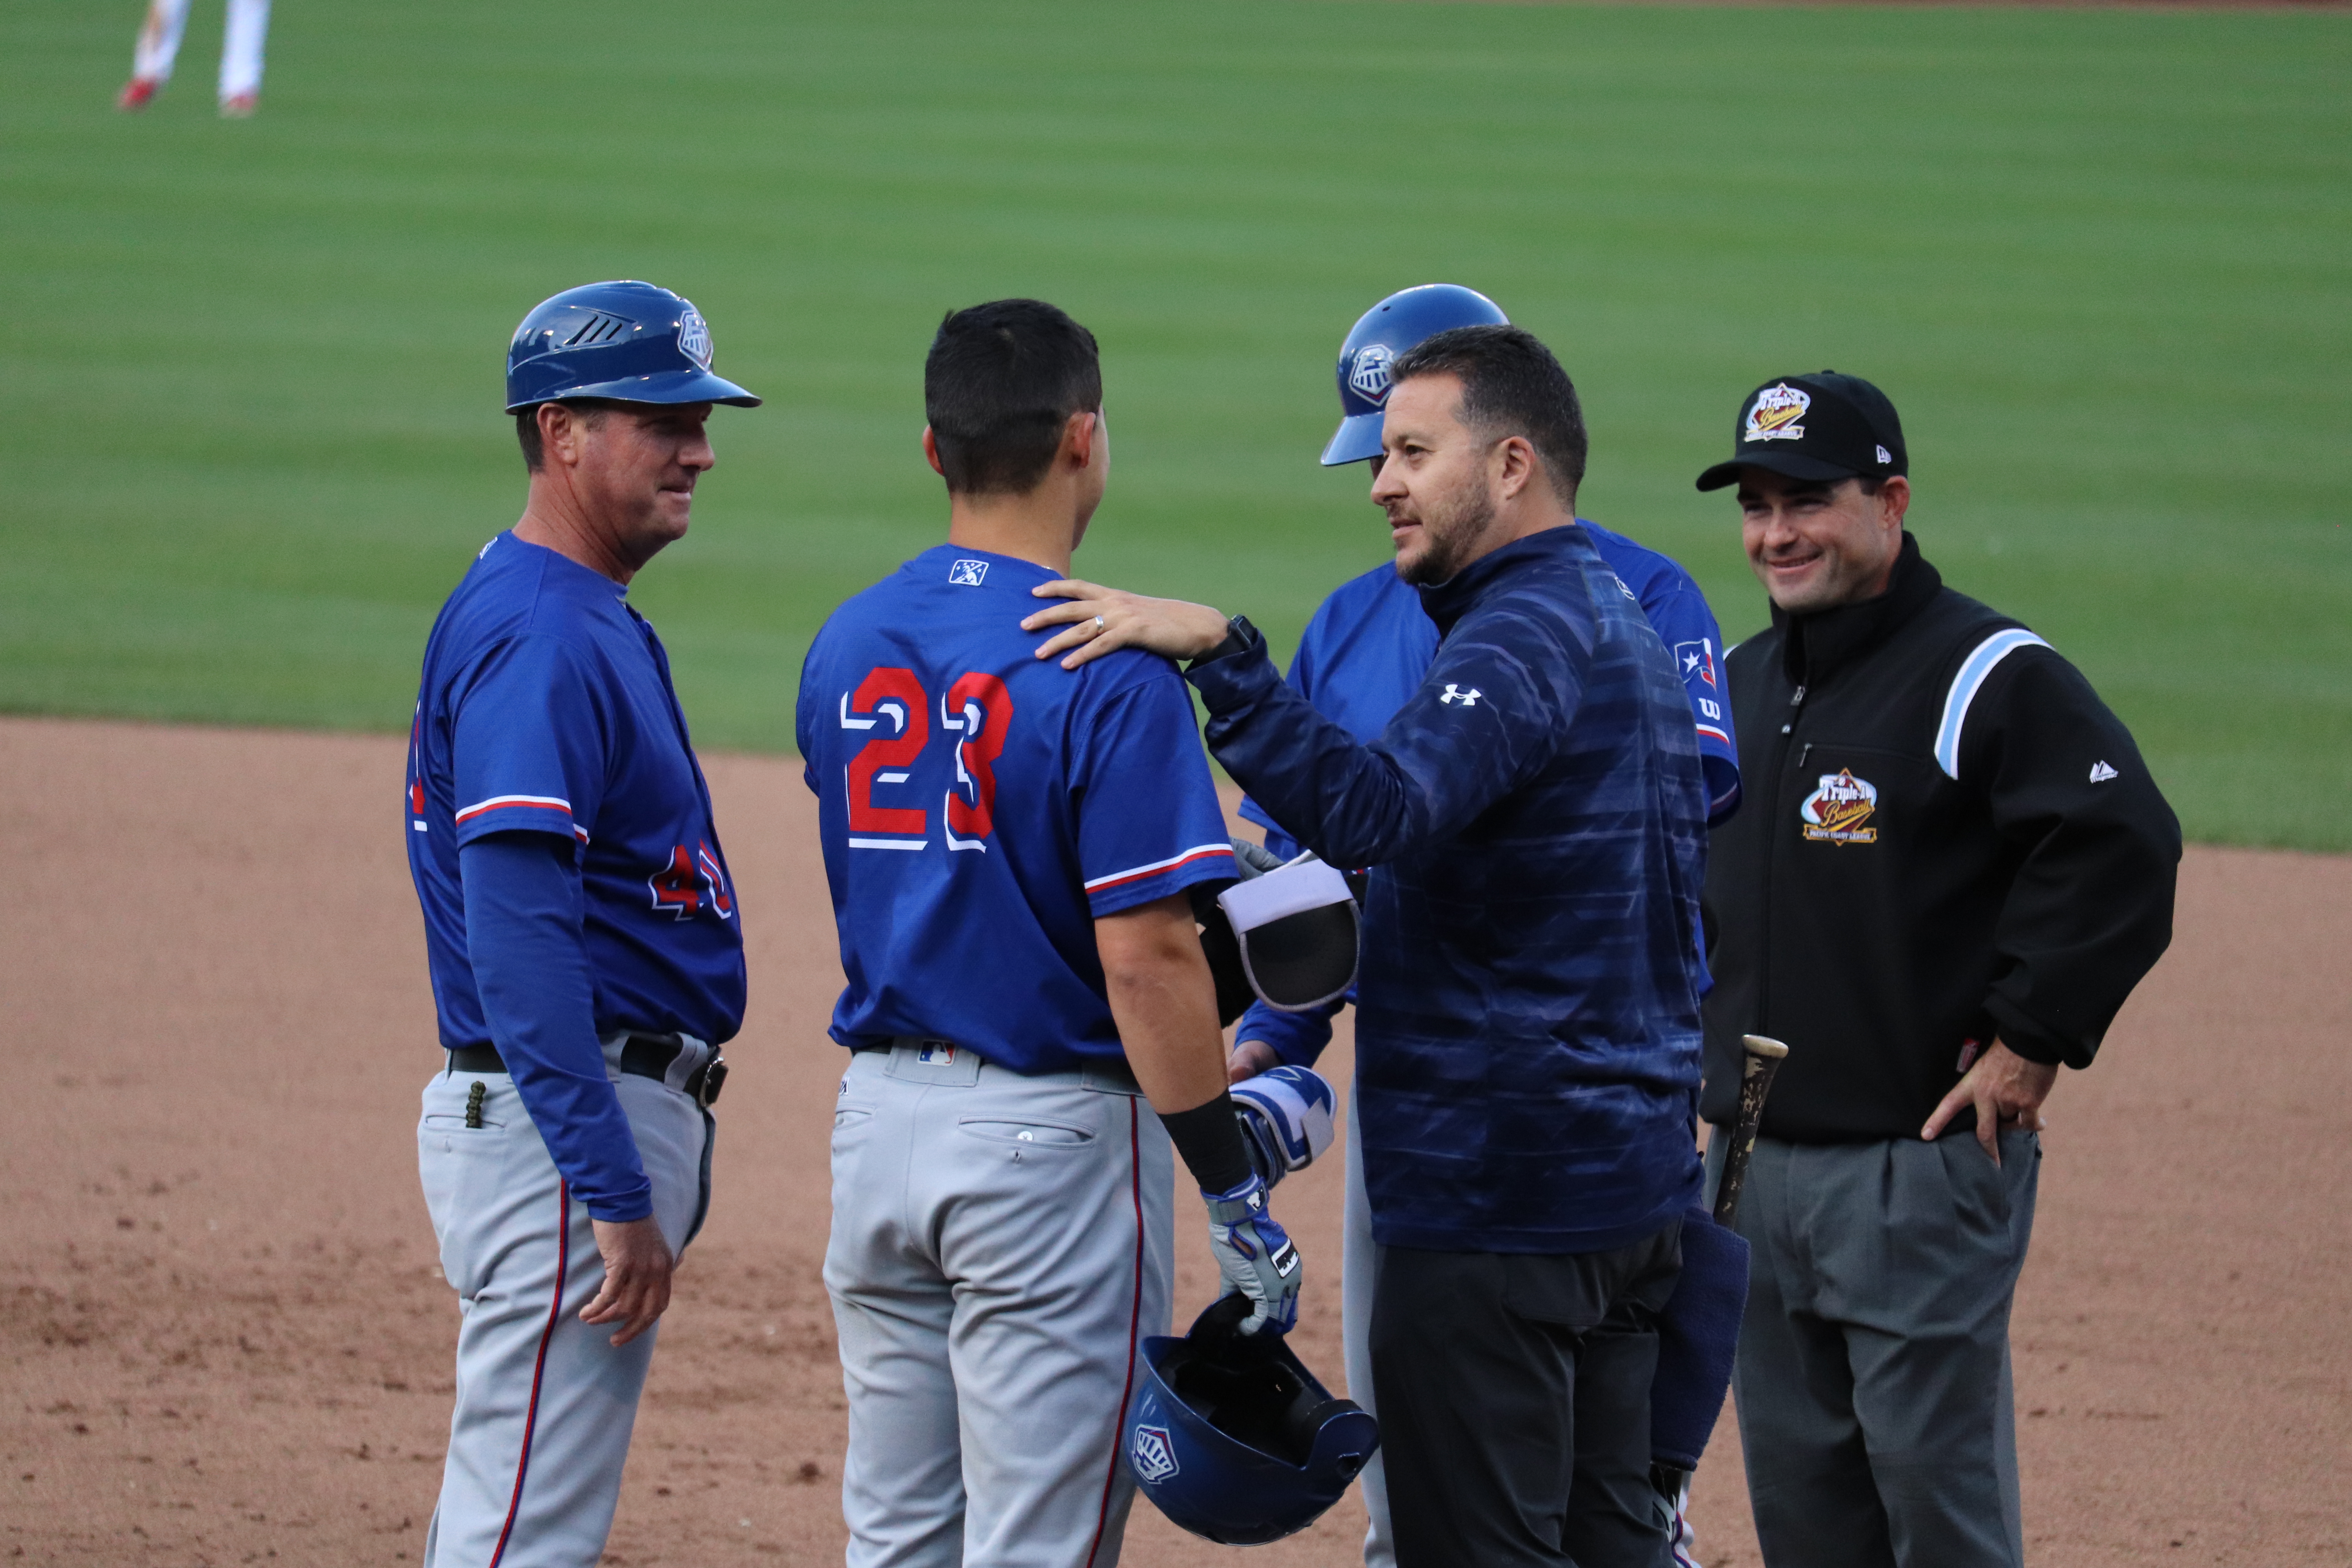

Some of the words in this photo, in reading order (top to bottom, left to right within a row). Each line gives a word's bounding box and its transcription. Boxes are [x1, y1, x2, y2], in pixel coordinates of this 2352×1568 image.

[1758, 404, 1803, 429] Baseball
[840, 666, 1014, 854] 23
[1819, 778, 1867, 805] Triple-A
[1821, 799, 1871, 827] Baseball
